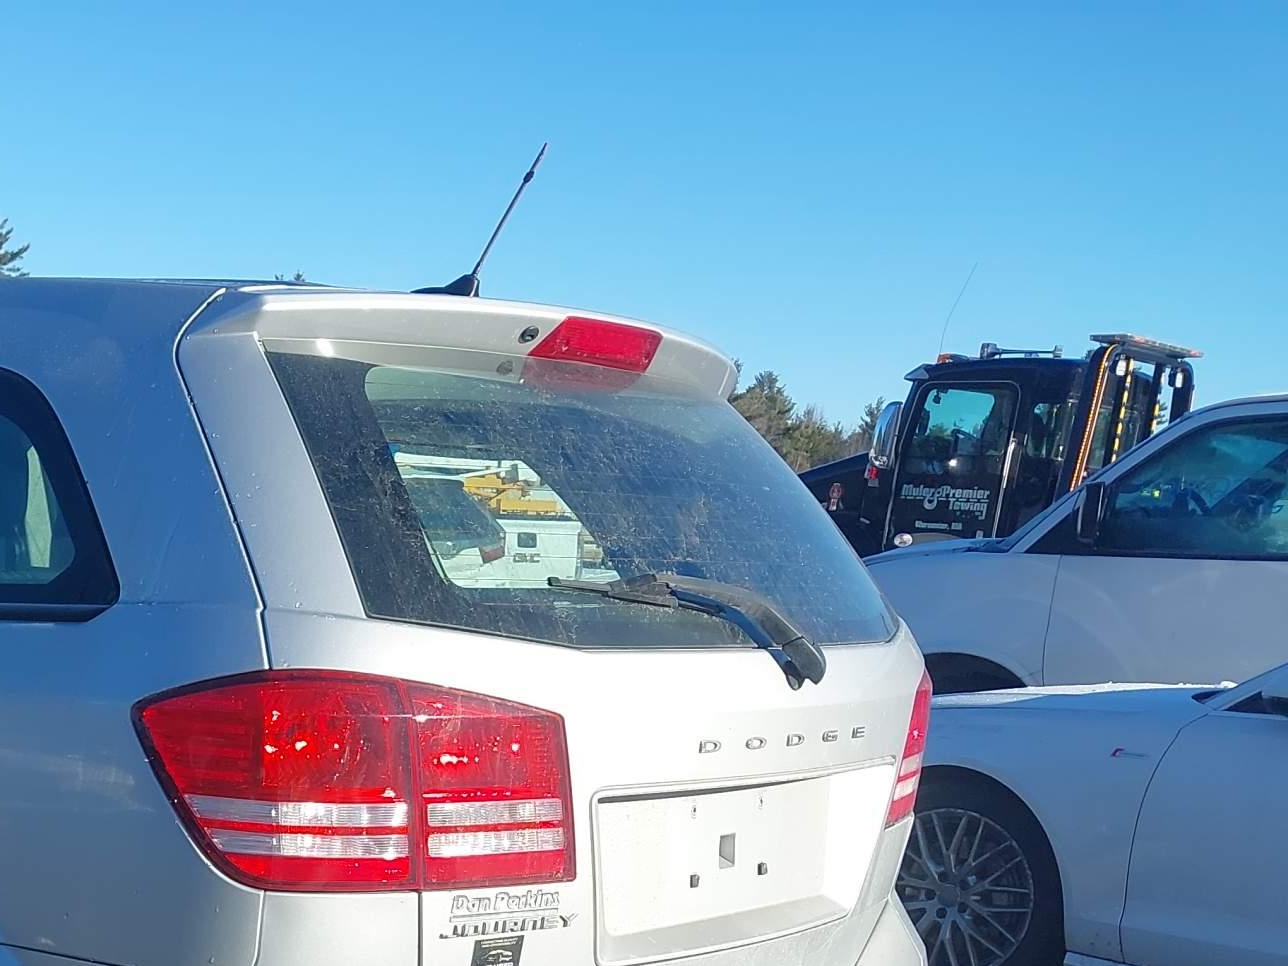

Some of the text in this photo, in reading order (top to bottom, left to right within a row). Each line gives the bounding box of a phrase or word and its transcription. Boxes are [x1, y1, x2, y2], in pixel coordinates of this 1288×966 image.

[941, 485, 990, 499] Premier
[948, 500, 989, 520] Towing
[698, 726, 866, 754] DODGE
[451, 889, 561, 914] Dan Perkins
[438, 912, 579, 939] JOURNEY
